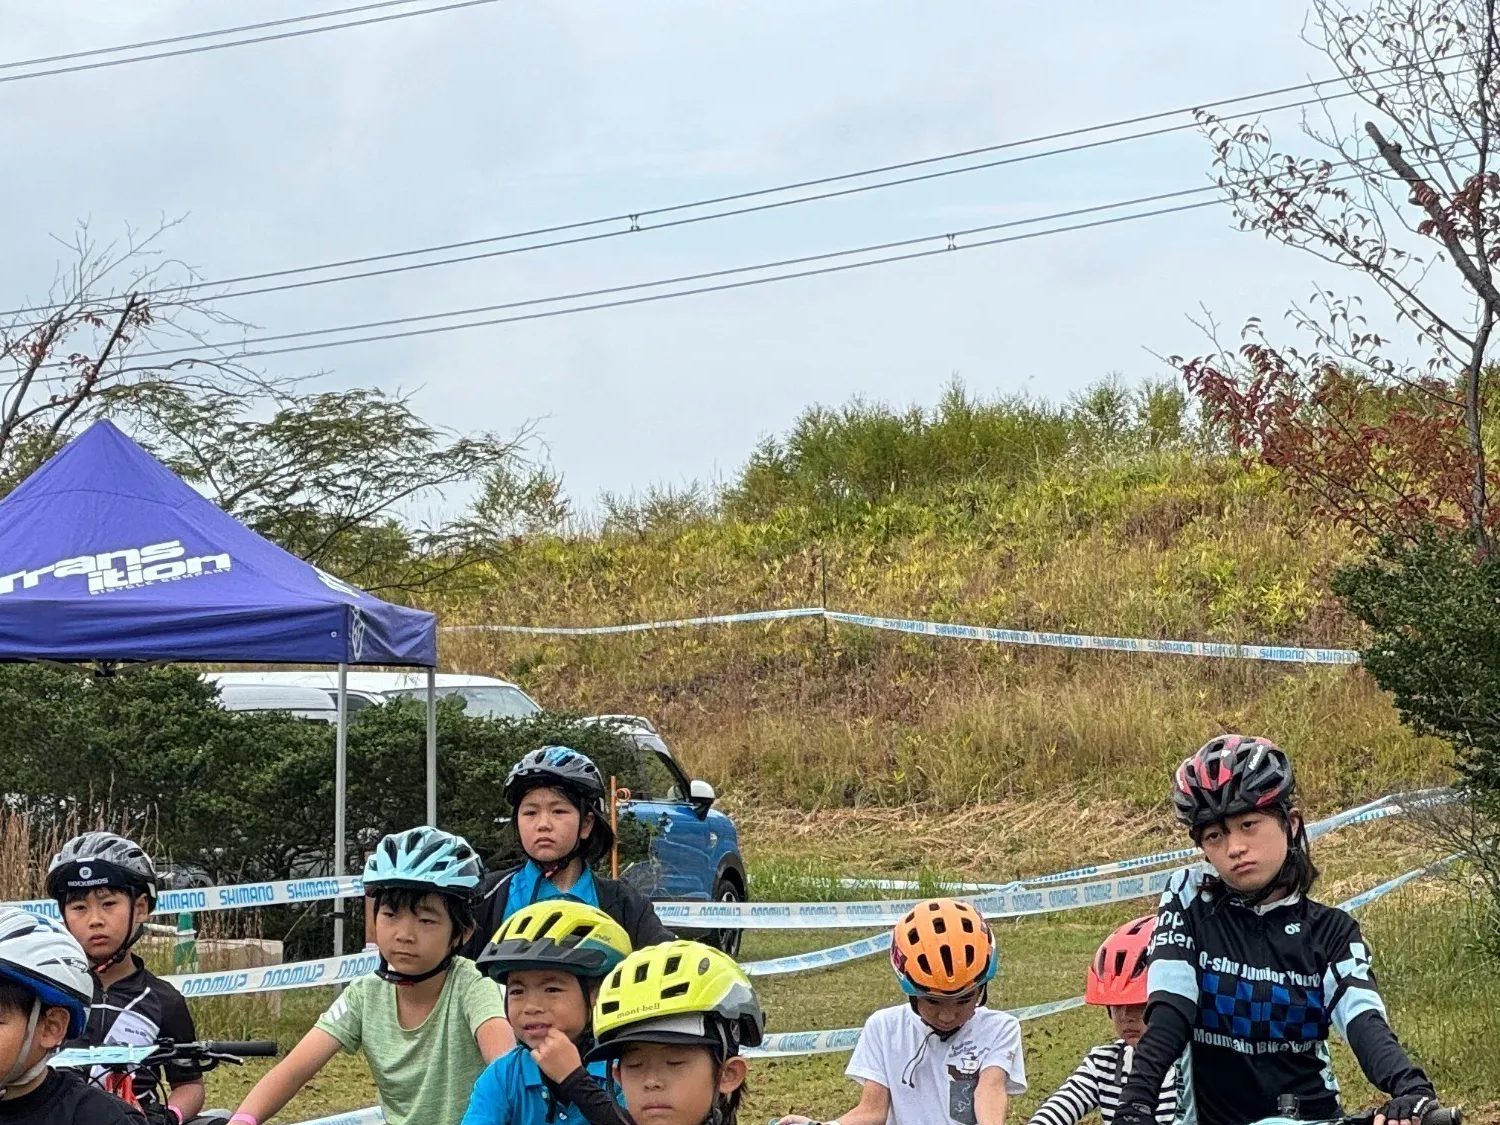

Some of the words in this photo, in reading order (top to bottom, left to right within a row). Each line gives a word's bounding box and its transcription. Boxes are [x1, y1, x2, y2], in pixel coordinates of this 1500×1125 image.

[161, 567, 232, 584] COMPANY
[1259, 648, 1306, 660] SHIMANO
[157, 891, 206, 911] HIMANO
[219, 885, 274, 906] SHIMANO
[286, 879, 340, 899] SHIMANO
[1199, 951, 1240, 976] Q-shu
[1240, 964, 1287, 985] Junior
